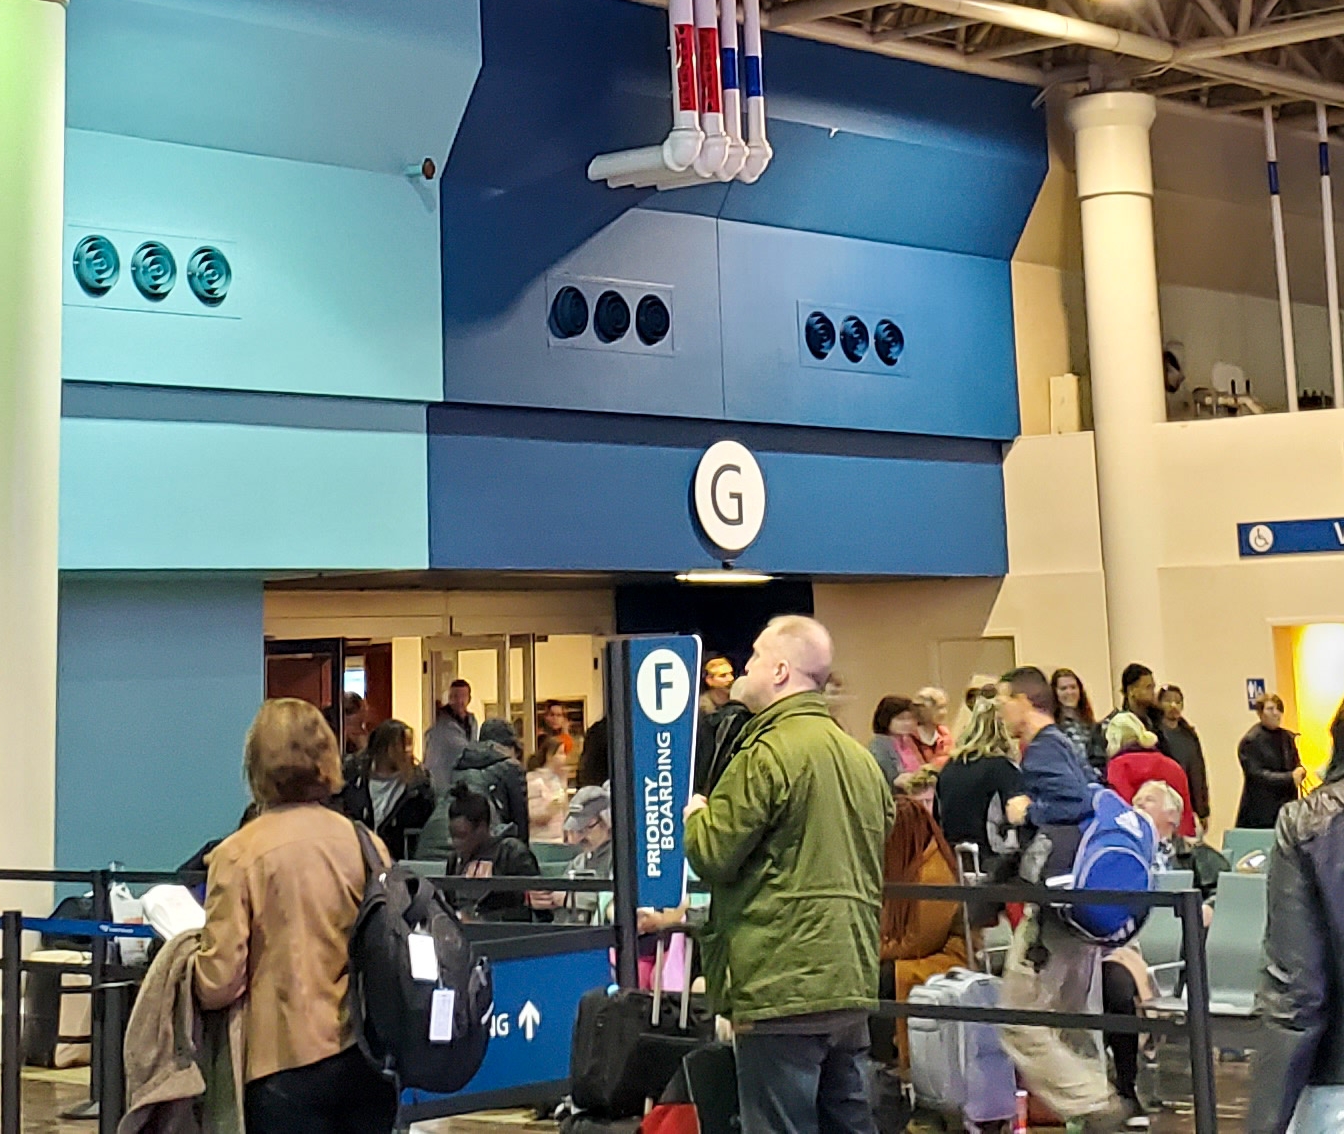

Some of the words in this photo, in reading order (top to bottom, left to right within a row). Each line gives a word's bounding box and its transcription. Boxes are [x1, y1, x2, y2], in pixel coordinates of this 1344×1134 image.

[711, 463, 744, 526] G
[654, 662, 673, 710] F
[644, 777, 662, 878] PRIORITY
[656, 732, 674, 851] BOARDING
